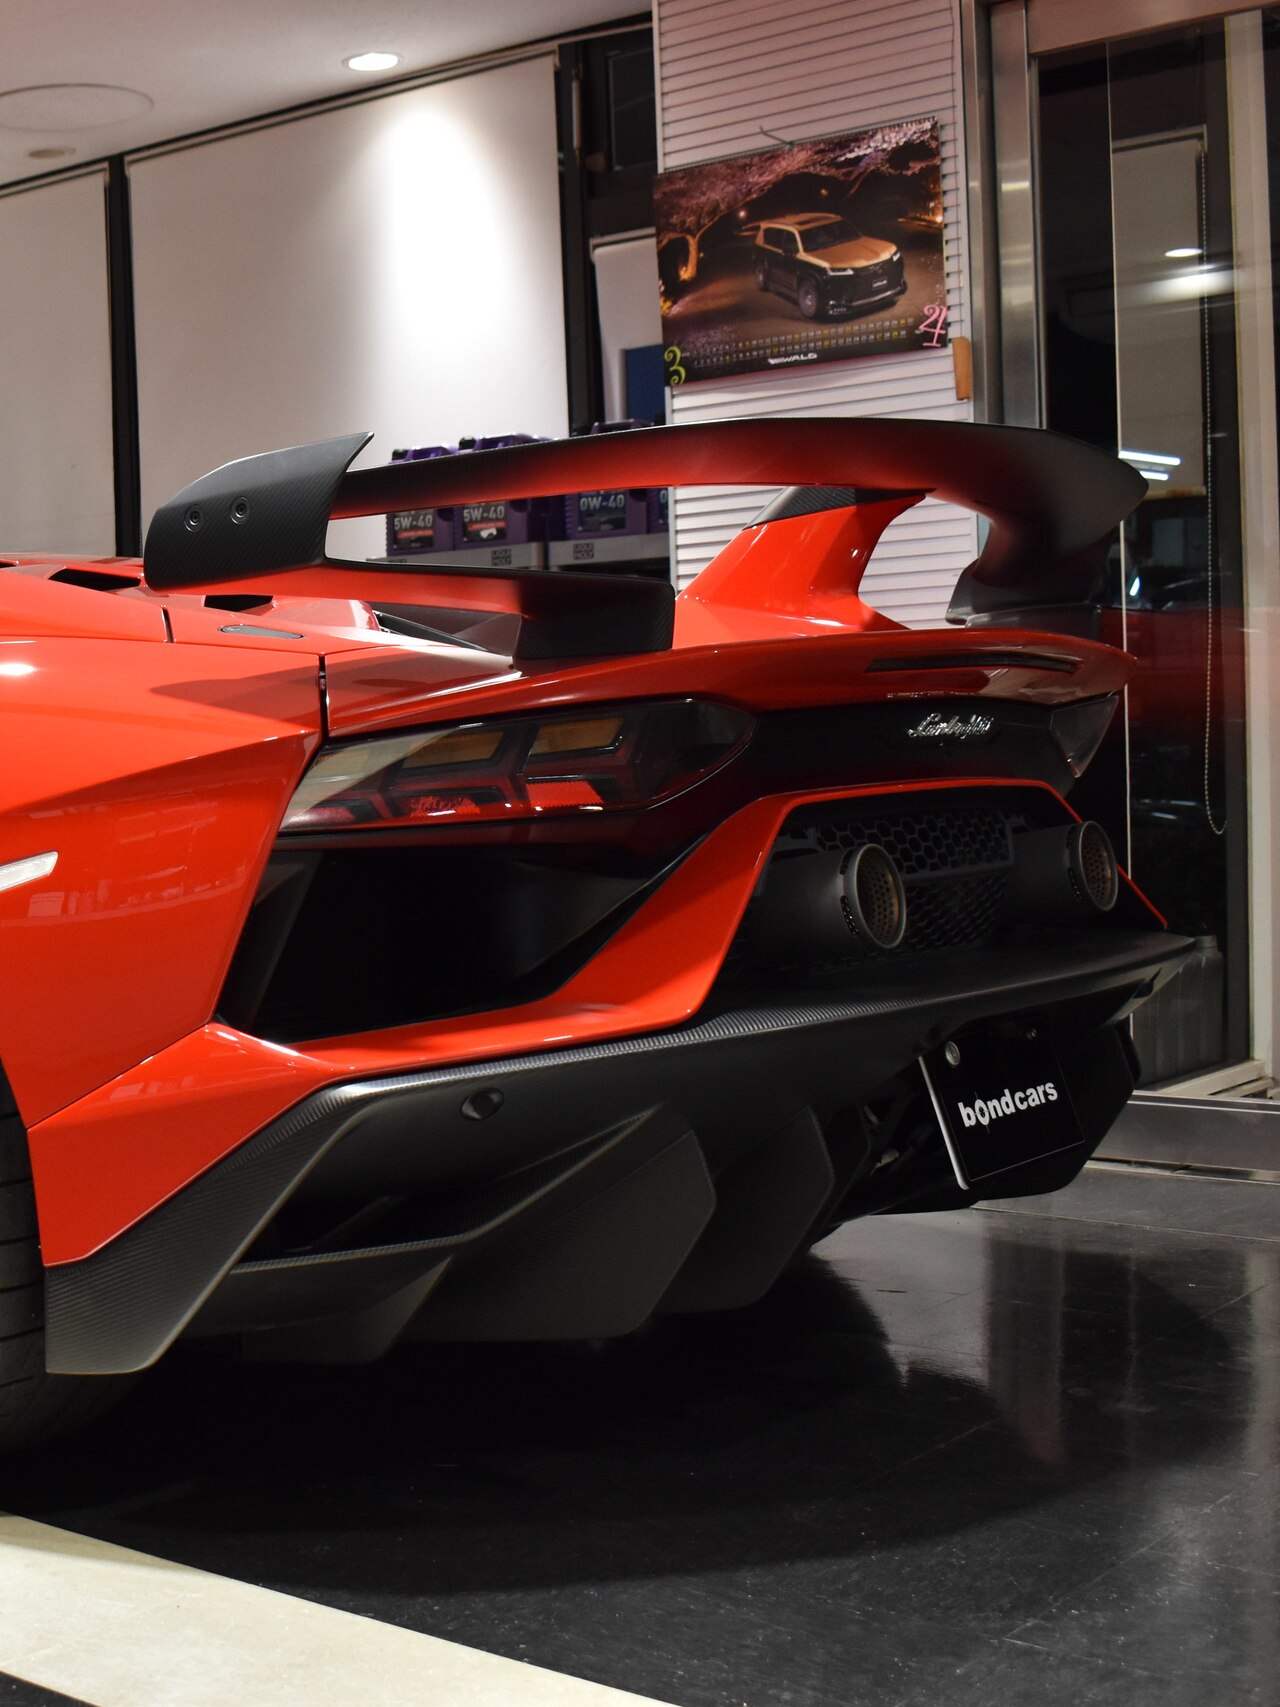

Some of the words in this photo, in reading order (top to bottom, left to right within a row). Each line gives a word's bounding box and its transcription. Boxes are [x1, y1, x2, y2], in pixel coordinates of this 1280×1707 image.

[918, 304, 947, 347] 4
[664, 346, 686, 385] 3
[579, 494, 625, 511] 0W-40
[394, 514, 433, 530] 5W-40
[463, 506, 505, 523] 5W-40
